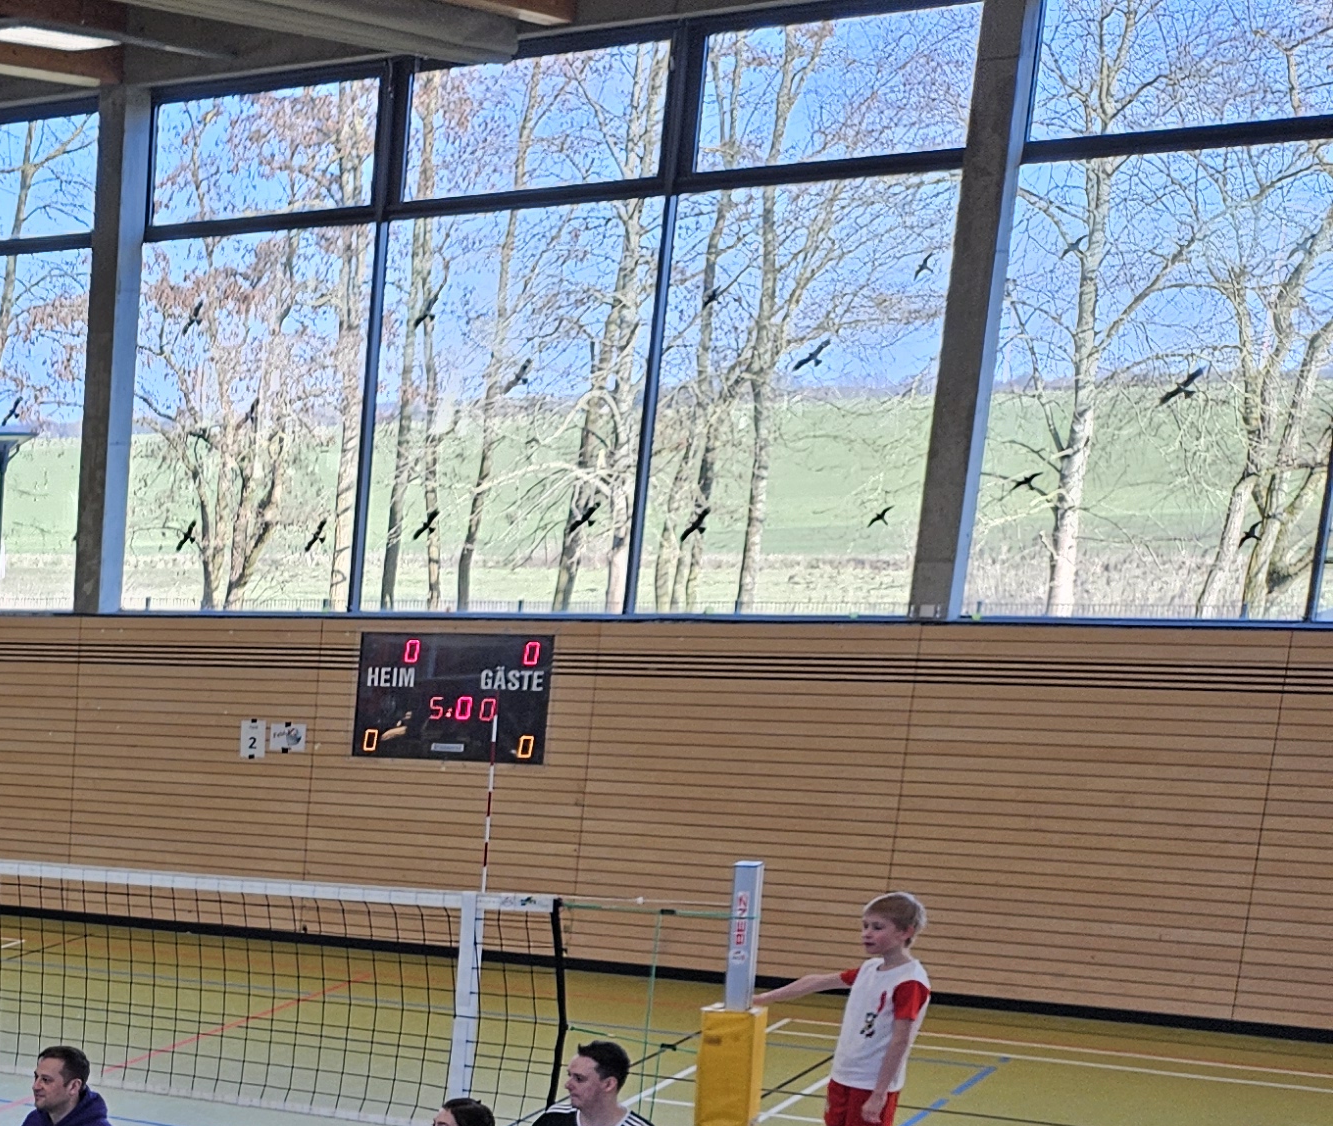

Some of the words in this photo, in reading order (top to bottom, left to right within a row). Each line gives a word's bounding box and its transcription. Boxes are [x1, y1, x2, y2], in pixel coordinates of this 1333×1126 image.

[404, 639, 421, 664] 0
[523, 641, 541, 666] 0
[366, 666, 416, 688] HEIM
[480, 666, 545, 692] GÄSTE
[248, 736, 257, 749] 2
[363, 729, 379, 752] 0
[517, 735, 535, 759] 0
